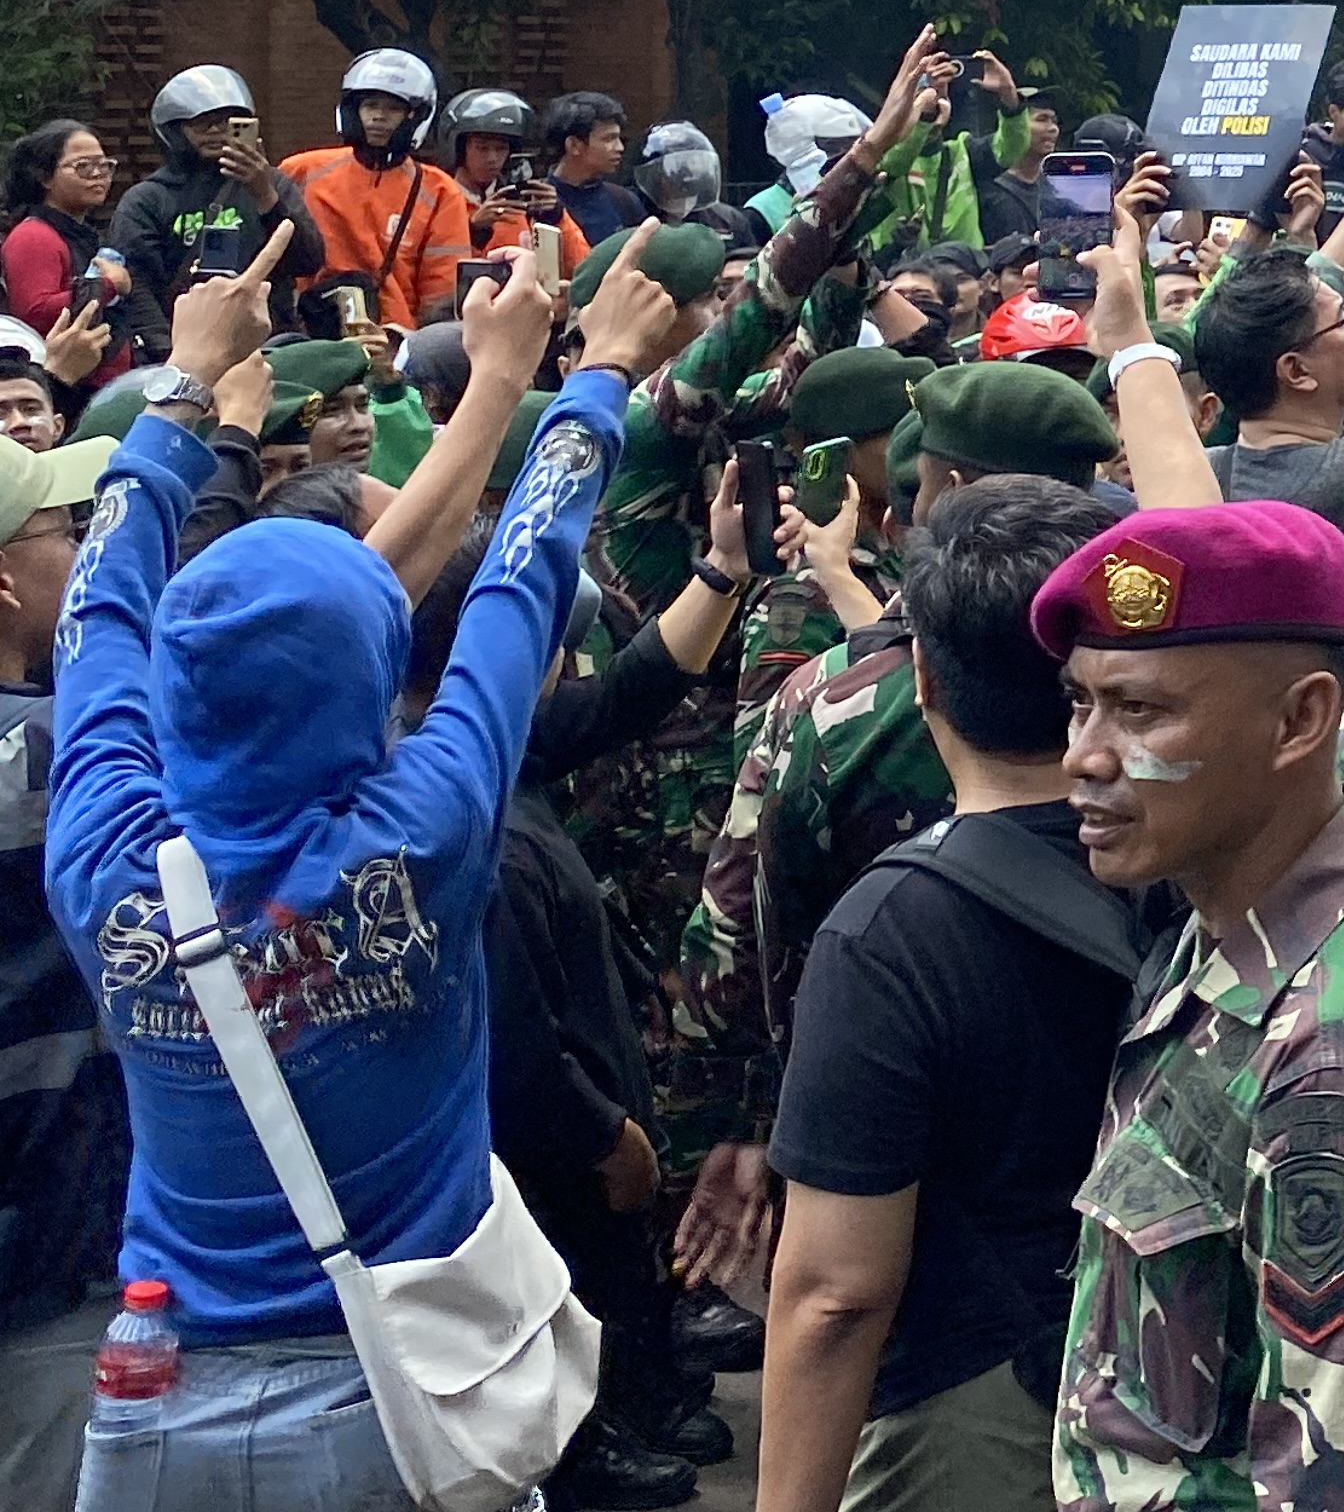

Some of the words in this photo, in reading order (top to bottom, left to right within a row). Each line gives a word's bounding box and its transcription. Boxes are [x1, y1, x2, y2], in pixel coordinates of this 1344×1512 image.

[1190, 43, 1258, 62] SAUDARA
[1259, 43, 1302, 61] KAMI
[1211, 61, 1269, 80] DILIBAS
[1201, 79, 1270, 98] DITINDAS
[1200, 97, 1260, 116] DIGILAS
[1181, 116, 1220, 135] OLEH
[1220, 115, 1271, 136] POLISI
